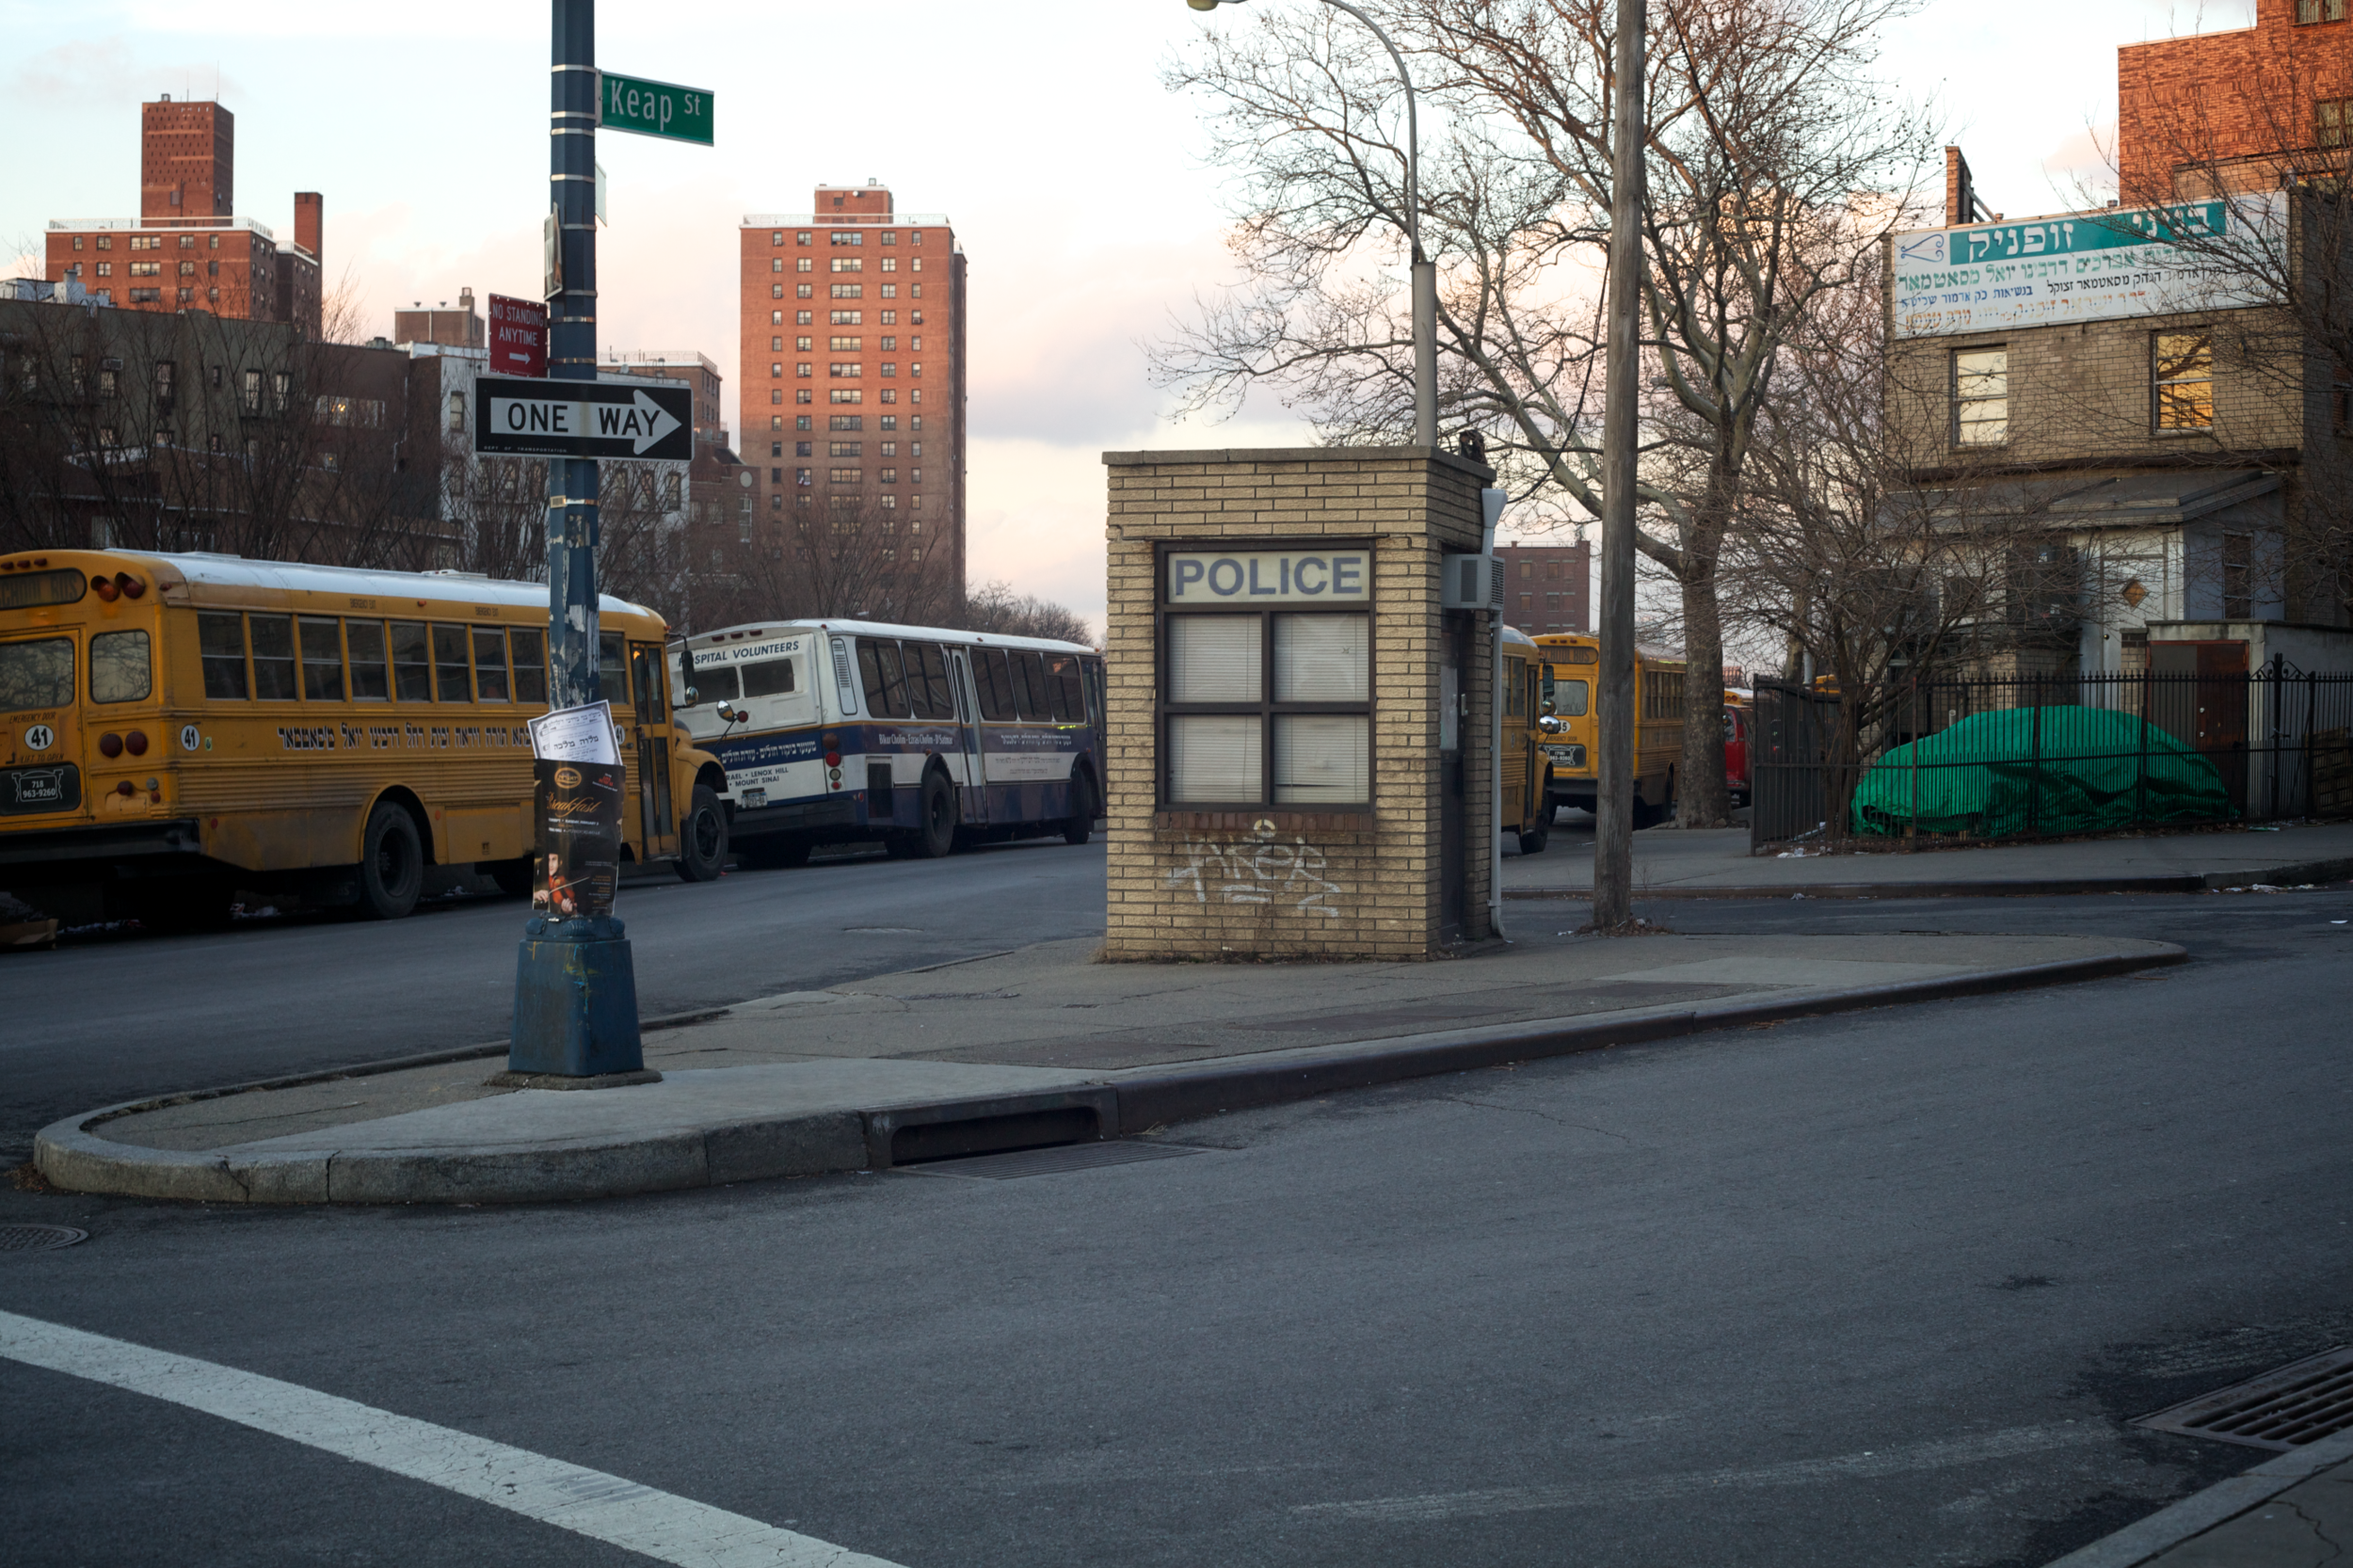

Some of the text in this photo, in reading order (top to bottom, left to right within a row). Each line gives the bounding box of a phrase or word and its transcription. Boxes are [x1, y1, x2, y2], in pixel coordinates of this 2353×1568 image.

[612, 79, 700, 132] Keap St
[1968, 222, 2073, 263] זופניק
[1898, 269, 1980, 292] מסאטמאר
[1986, 264, 2015, 282] יואל
[1993, 285, 2033, 298] בנשיאות
[2076, 275, 2130, 290] מסאטמאר
[492, 302, 544, 328] NO STANDING
[499, 326, 537, 346] ANYTIME
[507, 402, 661, 437] ONE WAY
[1176, 556, 1362, 596] POLICE
[679, 640, 799, 666] SPITAL VOLUNTEERS
[9, 711, 56, 725] EMERGENCY DOOR
[31, 728, 48, 746] 41
[184, 728, 196, 747] 41
[340, 721, 363, 749] יואל
[454, 726, 481, 748] ויראה
[485, 726, 507, 748] תורה
[553, 735, 599, 750] מלוה מלכה
[21, 755, 35, 763] LIFT
[47, 753, 64, 761] OPEN
[721, 748, 740, 764] חולים
[760, 744, 778, 760] חולים
[751, 769, 772, 777] LENOX
[32, 780, 44, 789] 718
[735, 778, 759, 787] MOUNT
[23, 788, 56, 799] 963-9260
[547, 792, 602, 818] Breakfast
